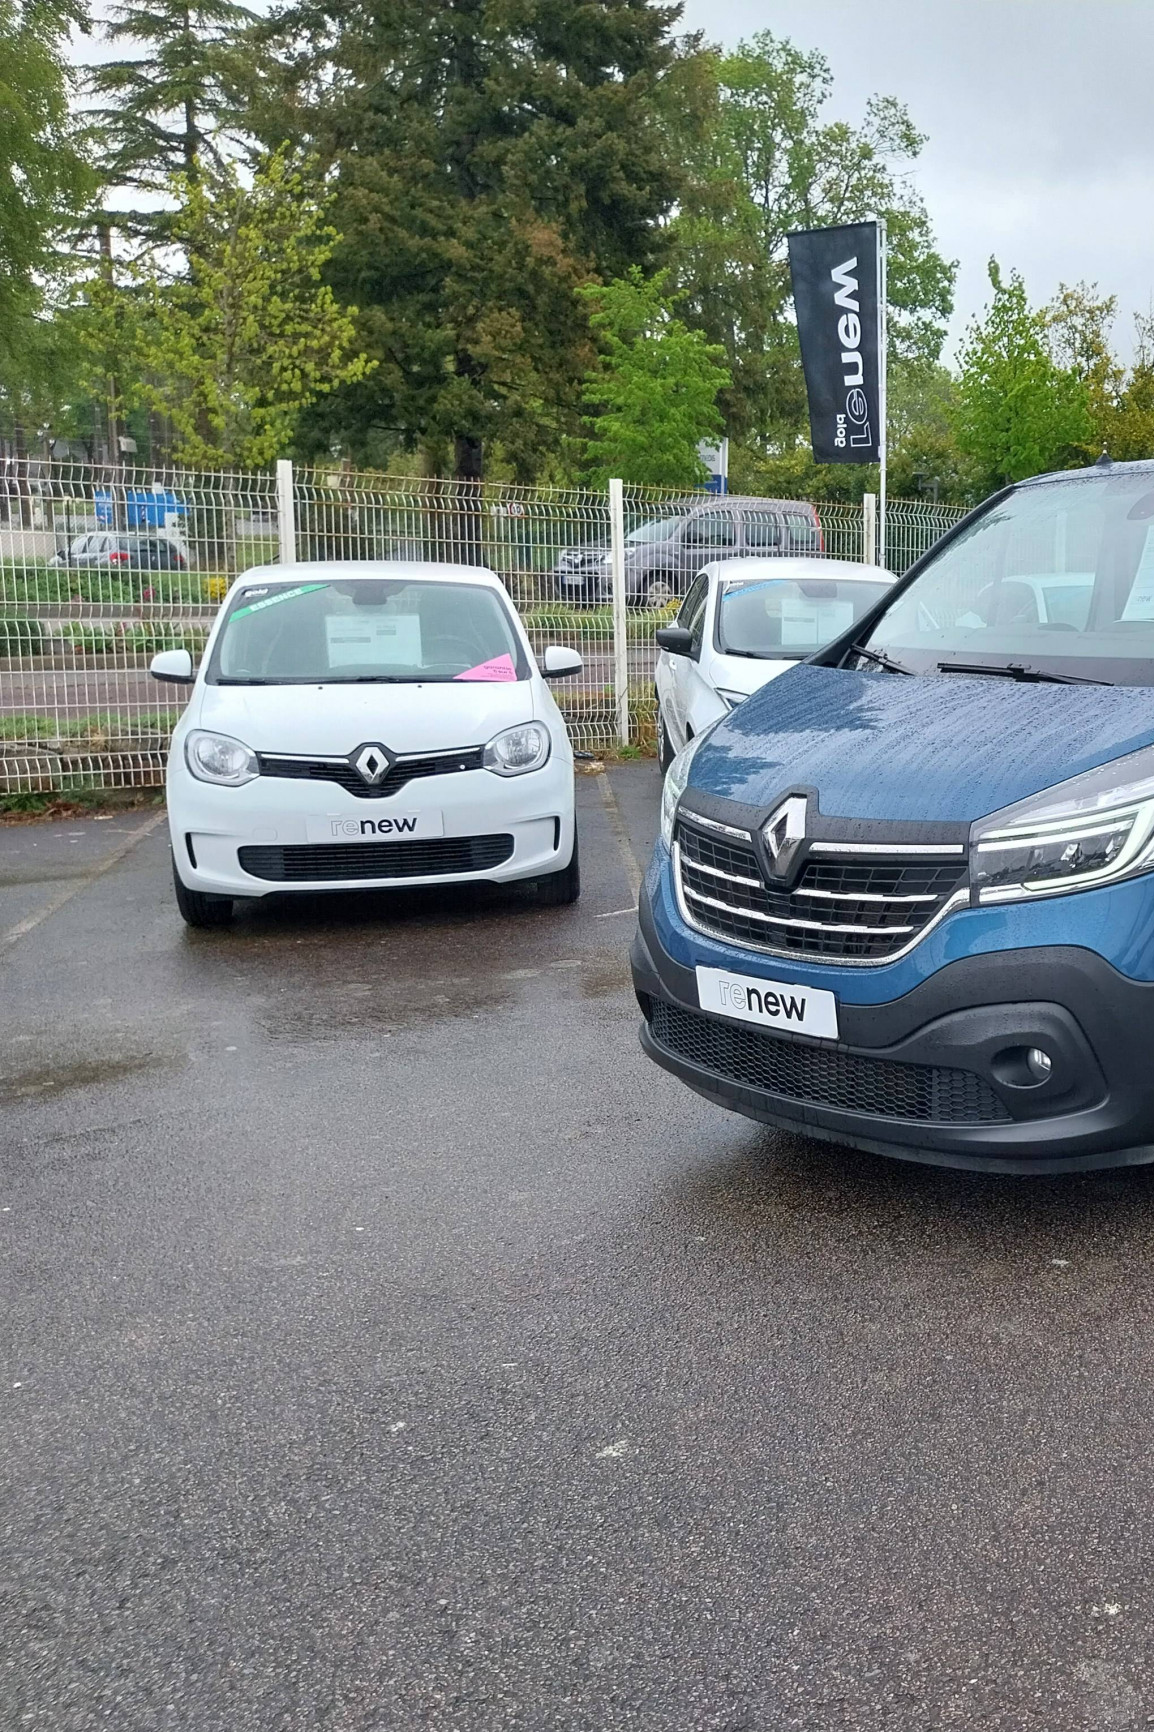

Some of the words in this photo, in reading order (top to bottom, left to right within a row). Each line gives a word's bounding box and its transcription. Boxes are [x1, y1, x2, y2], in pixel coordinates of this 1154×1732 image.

[249, 588, 305, 612] ESSENCE
[330, 817, 418, 837] renew
[718, 980, 806, 1022] renew
